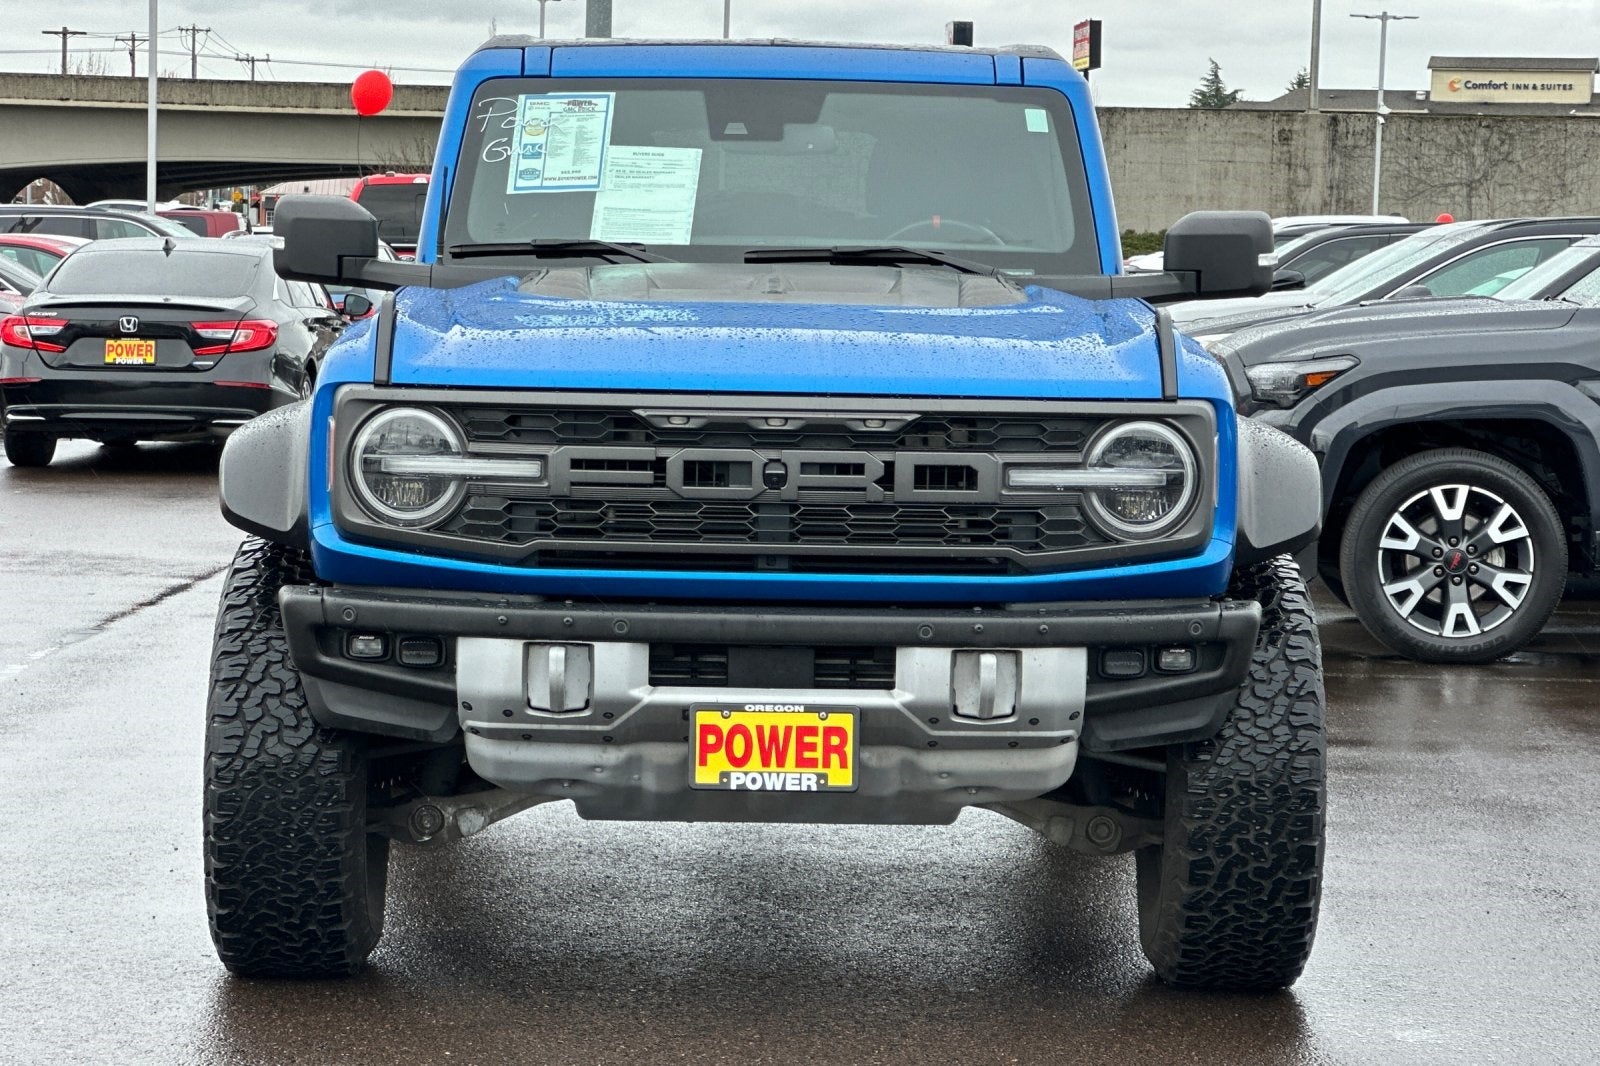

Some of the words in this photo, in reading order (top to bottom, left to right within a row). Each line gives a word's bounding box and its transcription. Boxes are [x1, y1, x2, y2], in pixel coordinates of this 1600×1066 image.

[1464, 79, 1508, 90] Comfort
[1540, 83, 1573, 91] SUITES
[106, 343, 154, 358] POWER
[549, 445, 1001, 504] FORD
[744, 704, 804, 712] OREGON
[698, 723, 848, 769] POWER
[730, 772, 818, 791] POWER
